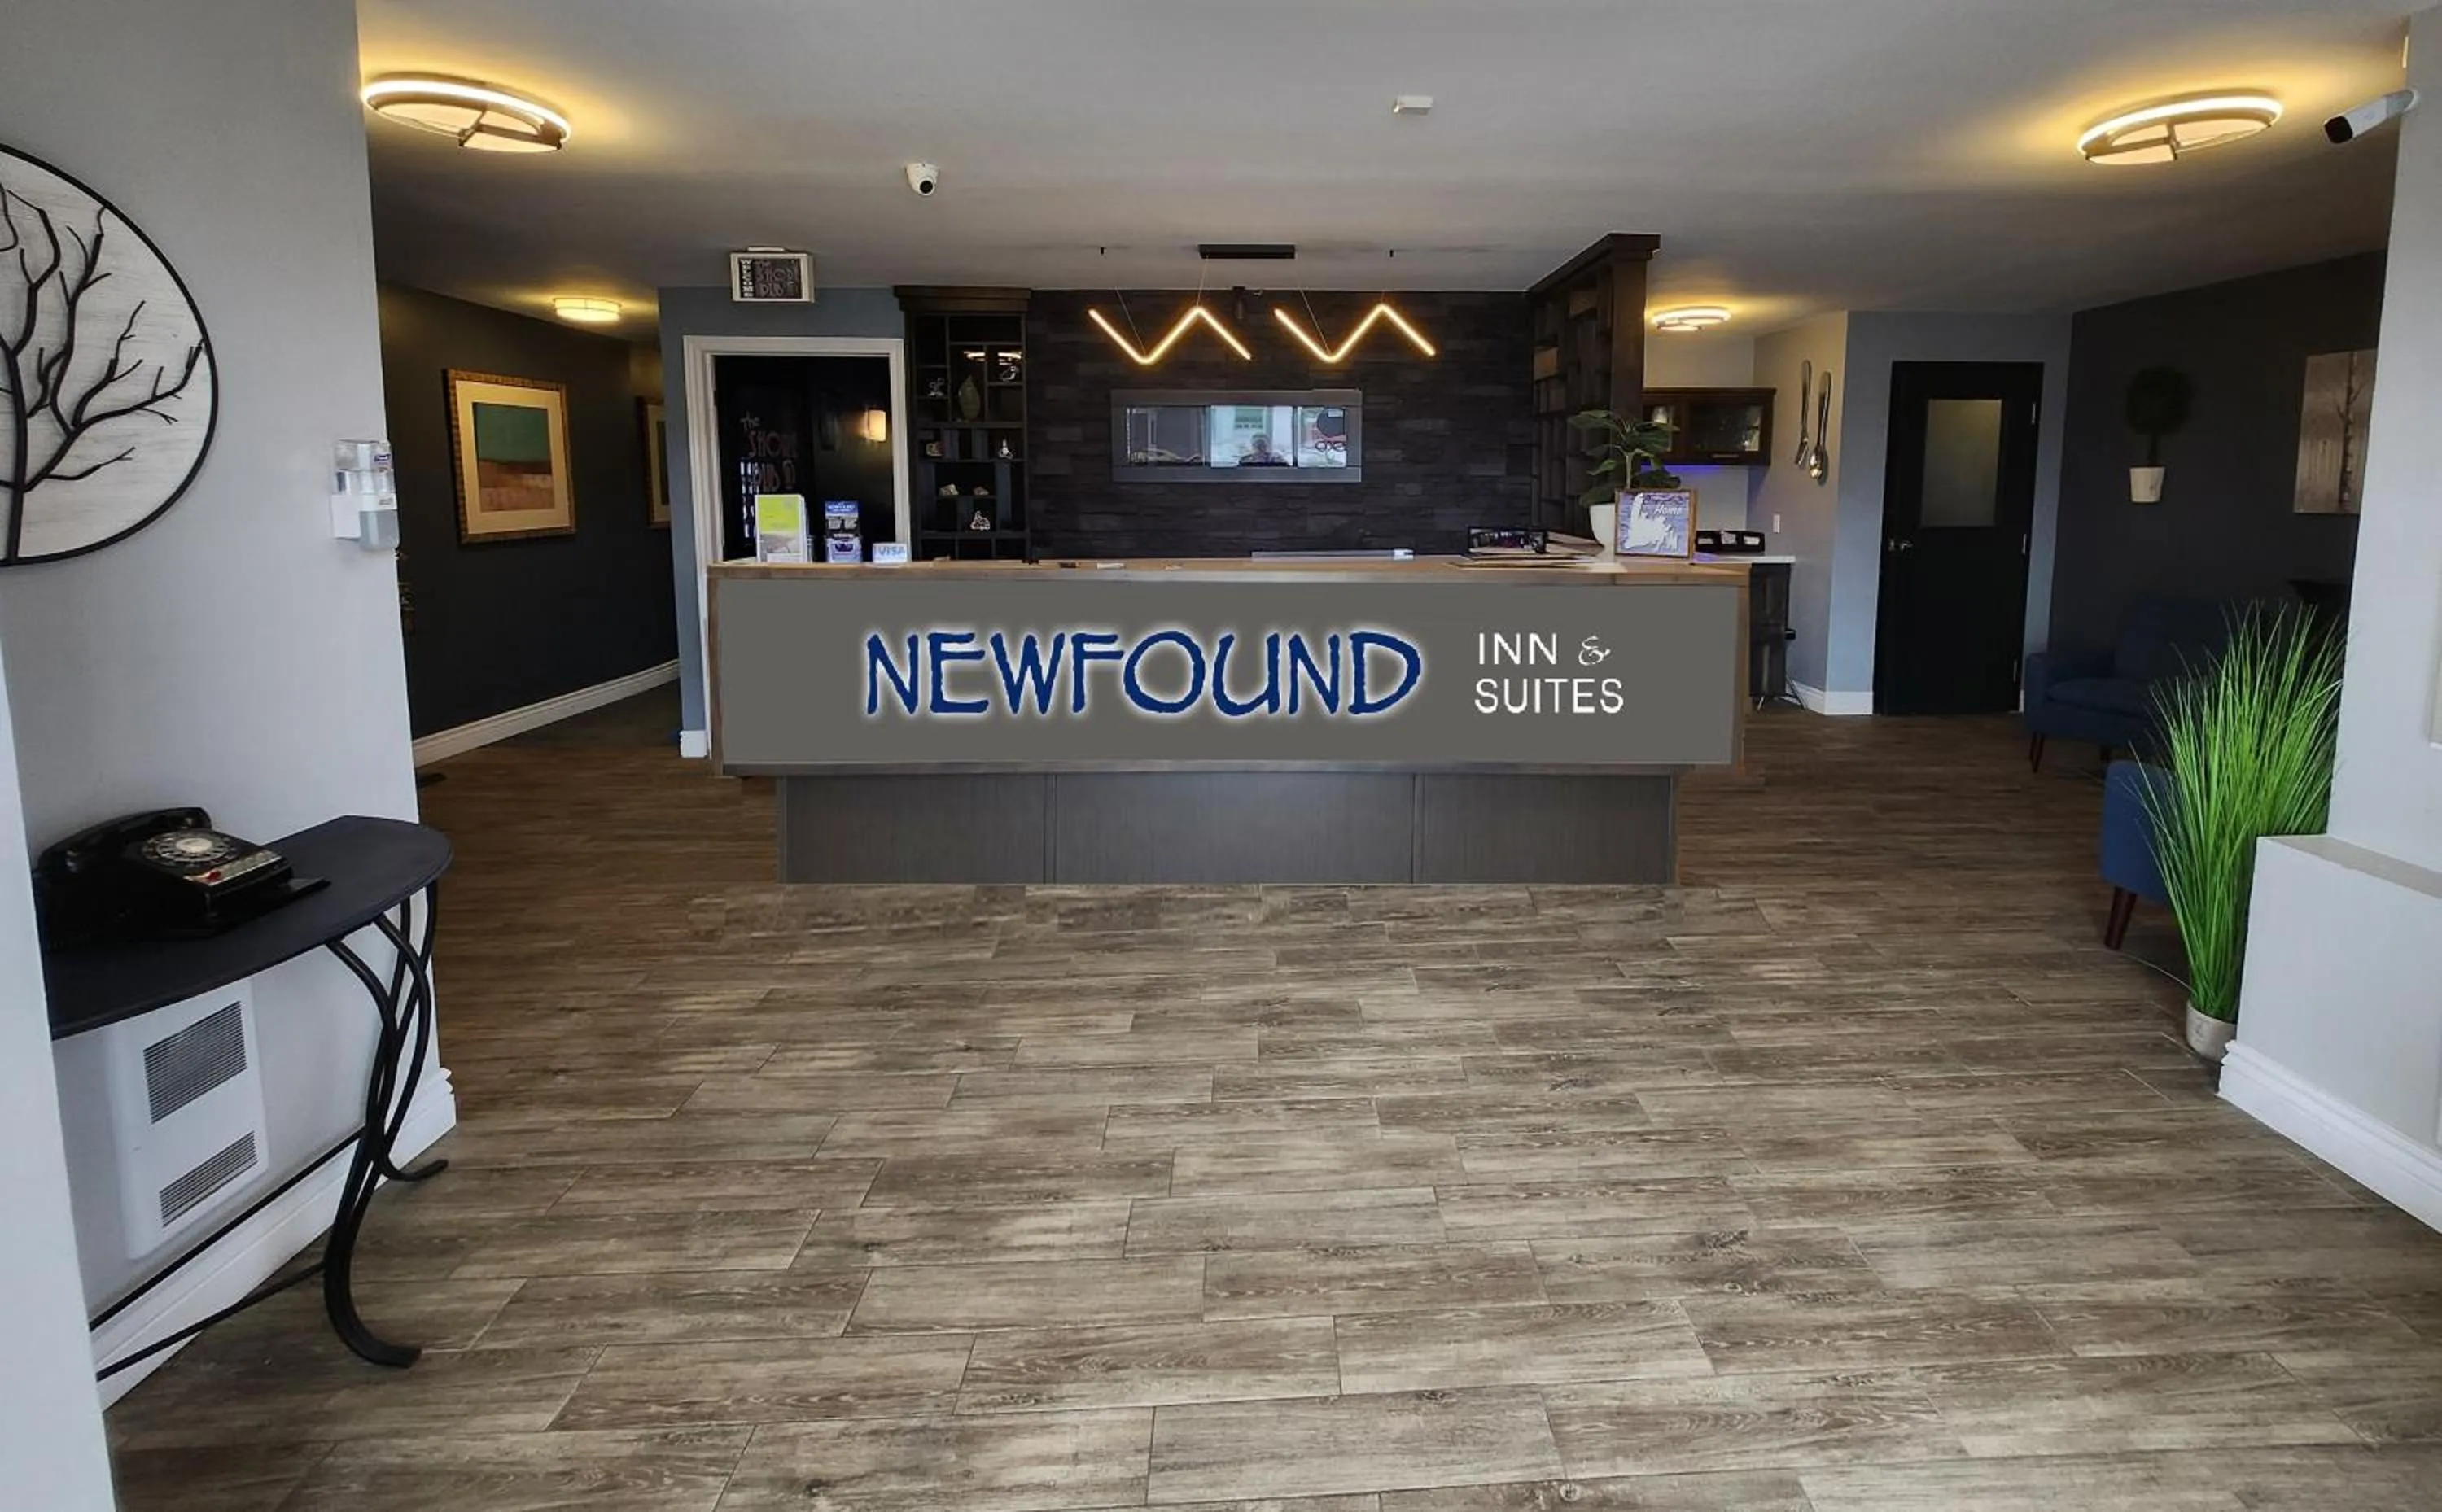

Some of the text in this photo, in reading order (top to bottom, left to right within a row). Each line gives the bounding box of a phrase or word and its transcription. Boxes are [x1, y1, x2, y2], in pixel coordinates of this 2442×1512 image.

[878, 546, 906, 557] VISA
[1480, 633, 1610, 666] INN &
[869, 632, 1420, 715] NEWFOUND
[1475, 679, 1623, 713] SUITES
